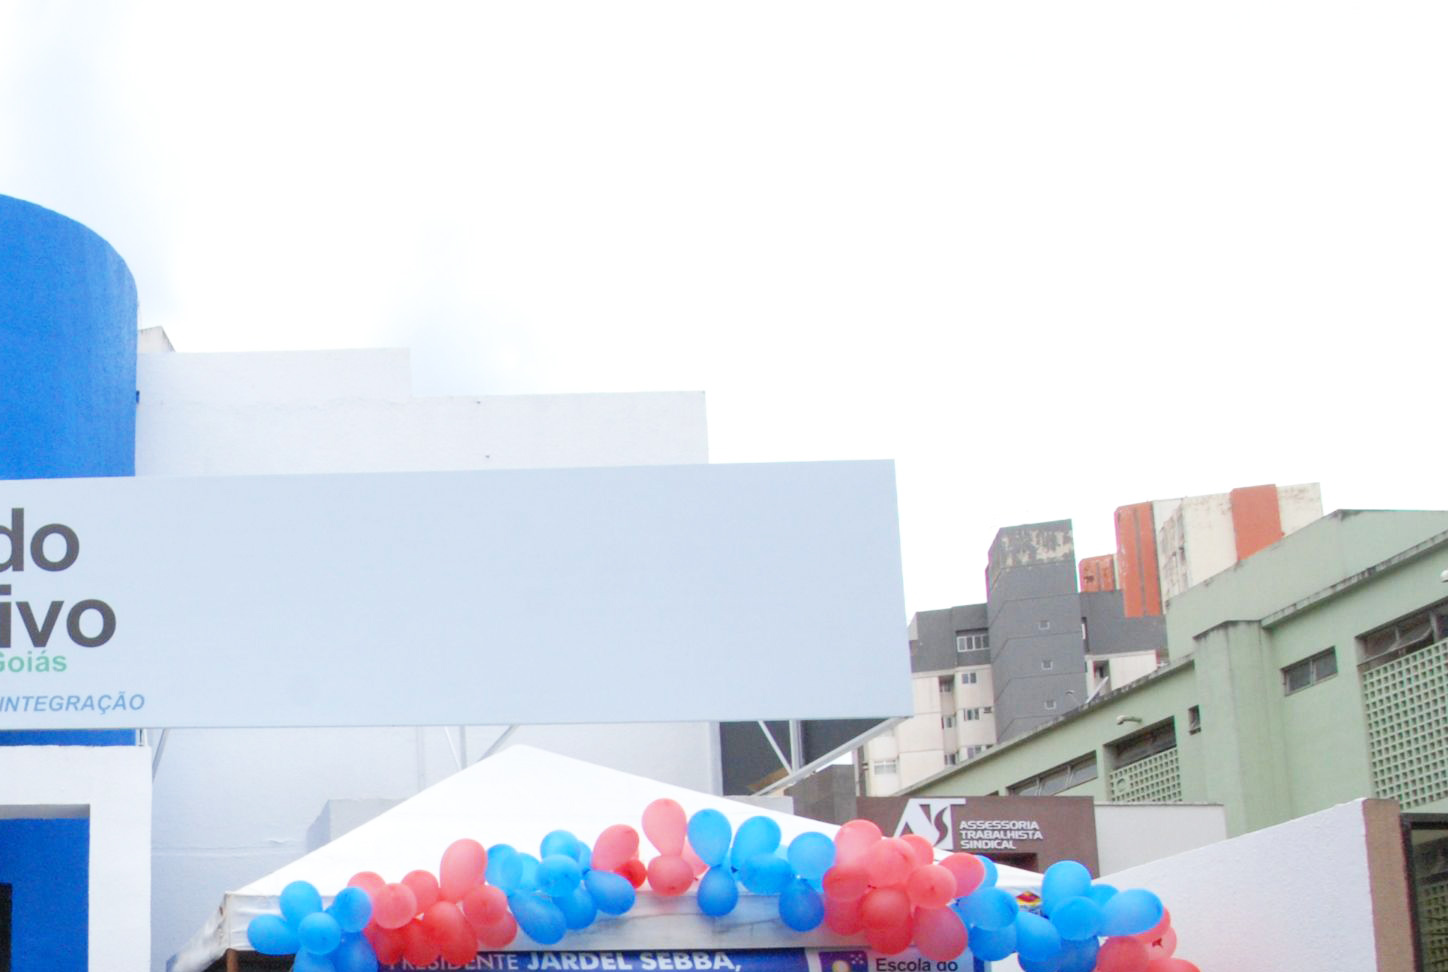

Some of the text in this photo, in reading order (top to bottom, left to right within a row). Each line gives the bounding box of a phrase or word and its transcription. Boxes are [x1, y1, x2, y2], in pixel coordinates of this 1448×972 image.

[959, 820, 1040, 830] ASSESSORIA
[959, 830, 1044, 840] TRABALHISTA
[960, 840, 1017, 849] SINDICAL
[527, 951, 633, 971] JARDEL
[641, 951, 742, 972] SEBBA,
[875, 957, 931, 972] Escola
